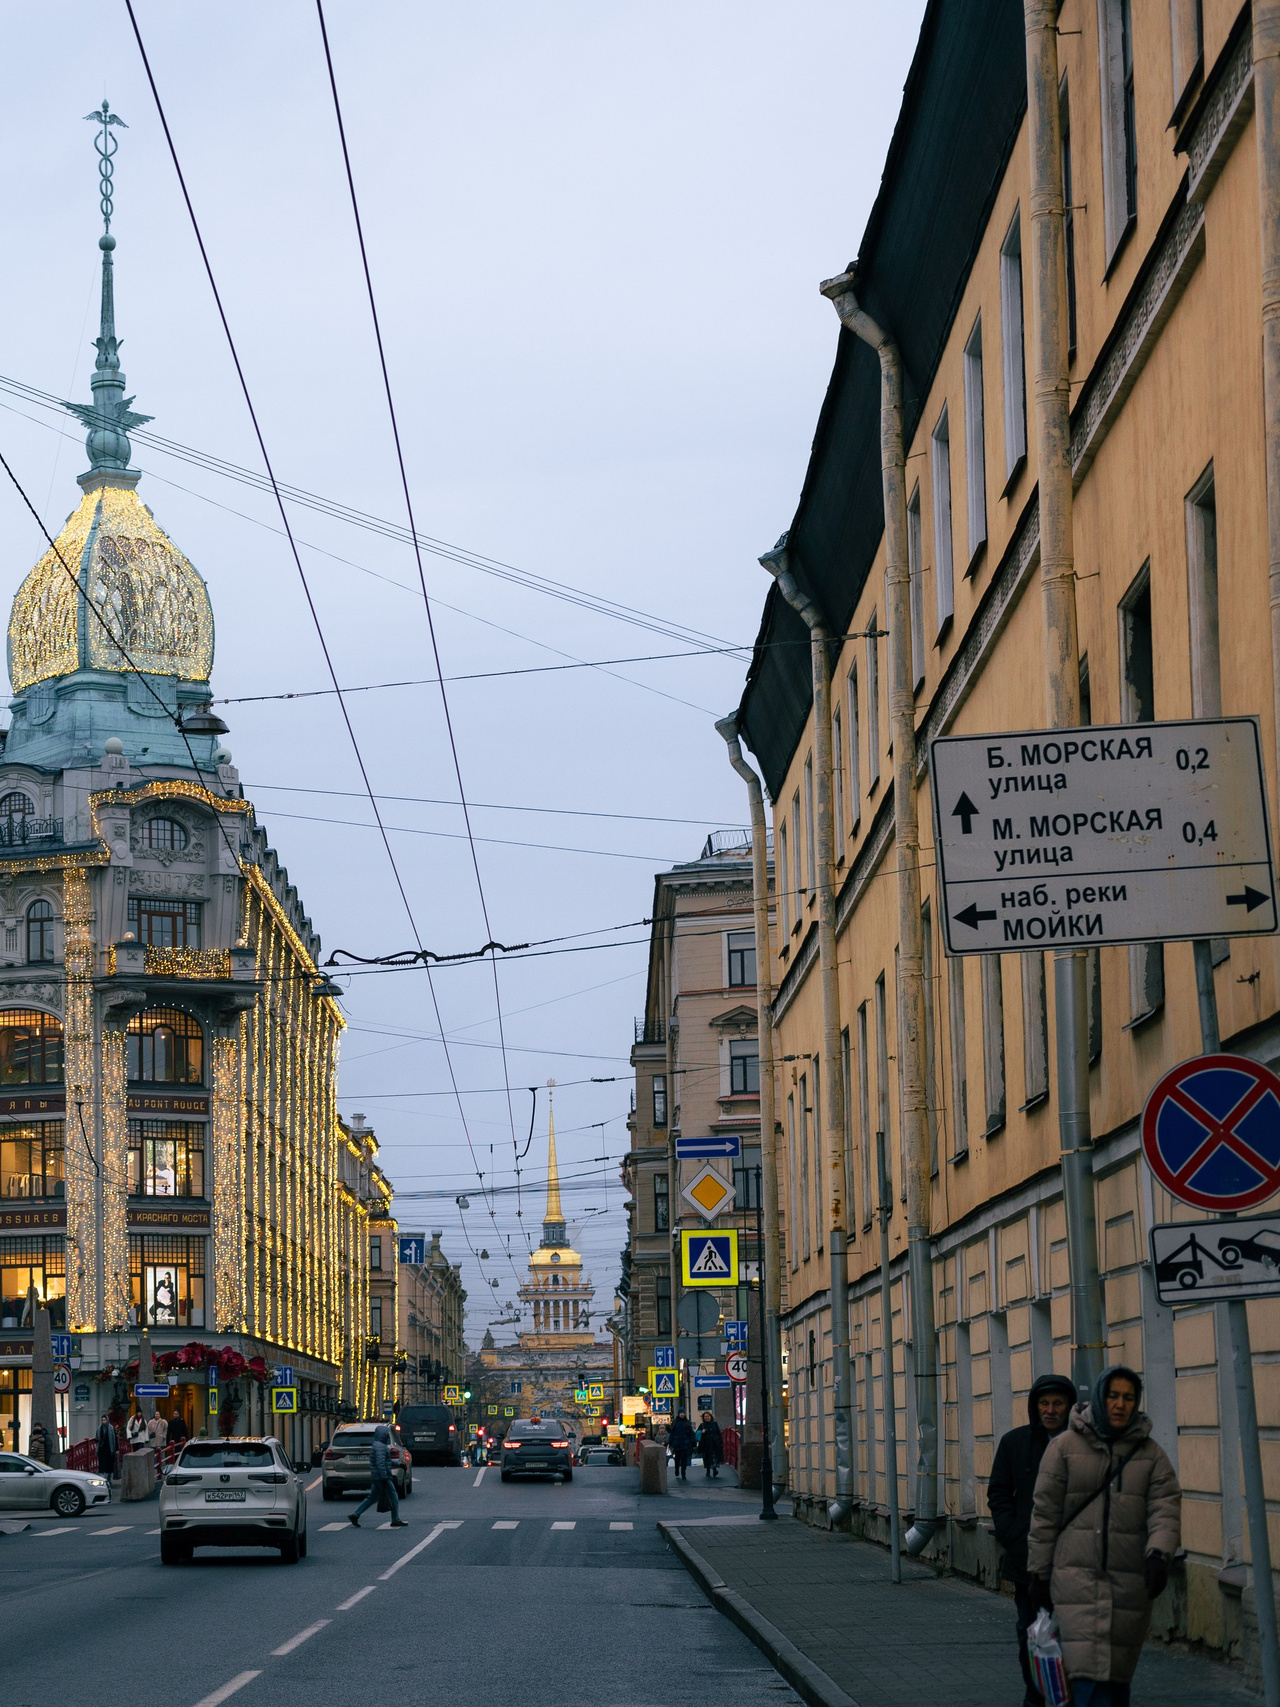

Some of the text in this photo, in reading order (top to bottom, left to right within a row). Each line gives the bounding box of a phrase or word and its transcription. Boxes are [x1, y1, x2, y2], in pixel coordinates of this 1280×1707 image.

[986, 736, 1153, 769] Б. МОРСКАЯ
[1176, 747, 1210, 774] 0,2
[988, 771, 1068, 800] улица
[992, 807, 1164, 840] М. МОРСКАЯ
[1182, 819, 1218, 847] 0,4
[993, 844, 1074, 872] улица
[147, 873, 184, 890] 1907
[1000, 883, 1128, 909] наб. реки
[1003, 910, 1104, 942] МОЙКИ
[128, 1098, 206, 1110] AU PONT ROUGE
[136, 1213, 179, 1223] КРАСНАГО
[181, 1214, 209, 1223] МОСТА
[54, 1372, 67, 1384] 40
